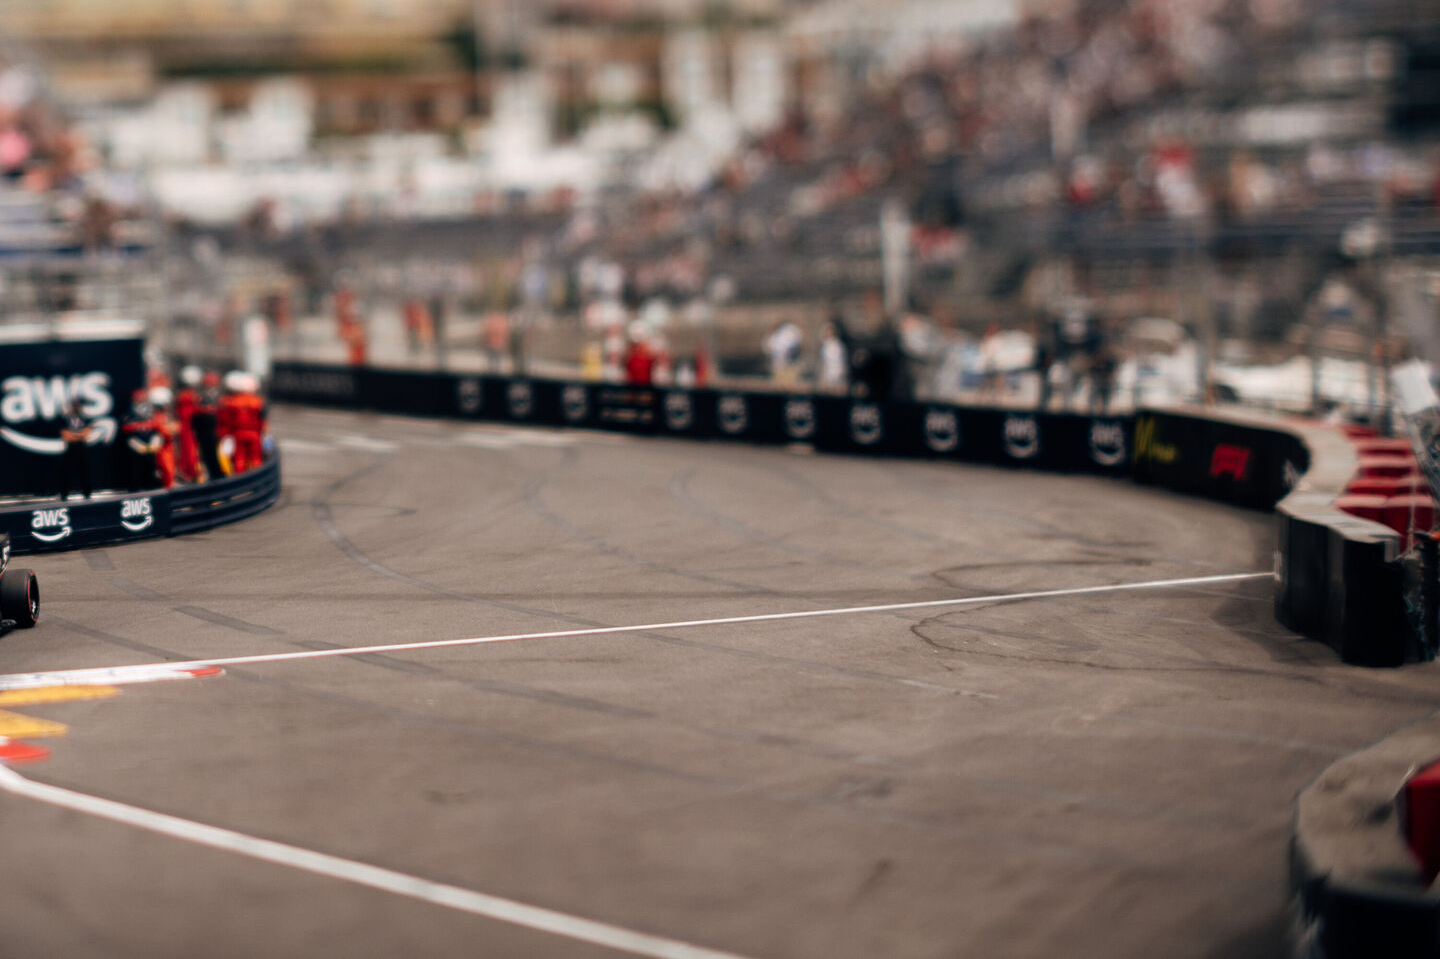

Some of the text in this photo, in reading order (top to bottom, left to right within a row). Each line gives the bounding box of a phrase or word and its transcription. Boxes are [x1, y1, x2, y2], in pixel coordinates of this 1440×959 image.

[0, 372, 113, 422] aws
[31, 508, 70, 529] aws
[121, 498, 151, 518] aws
